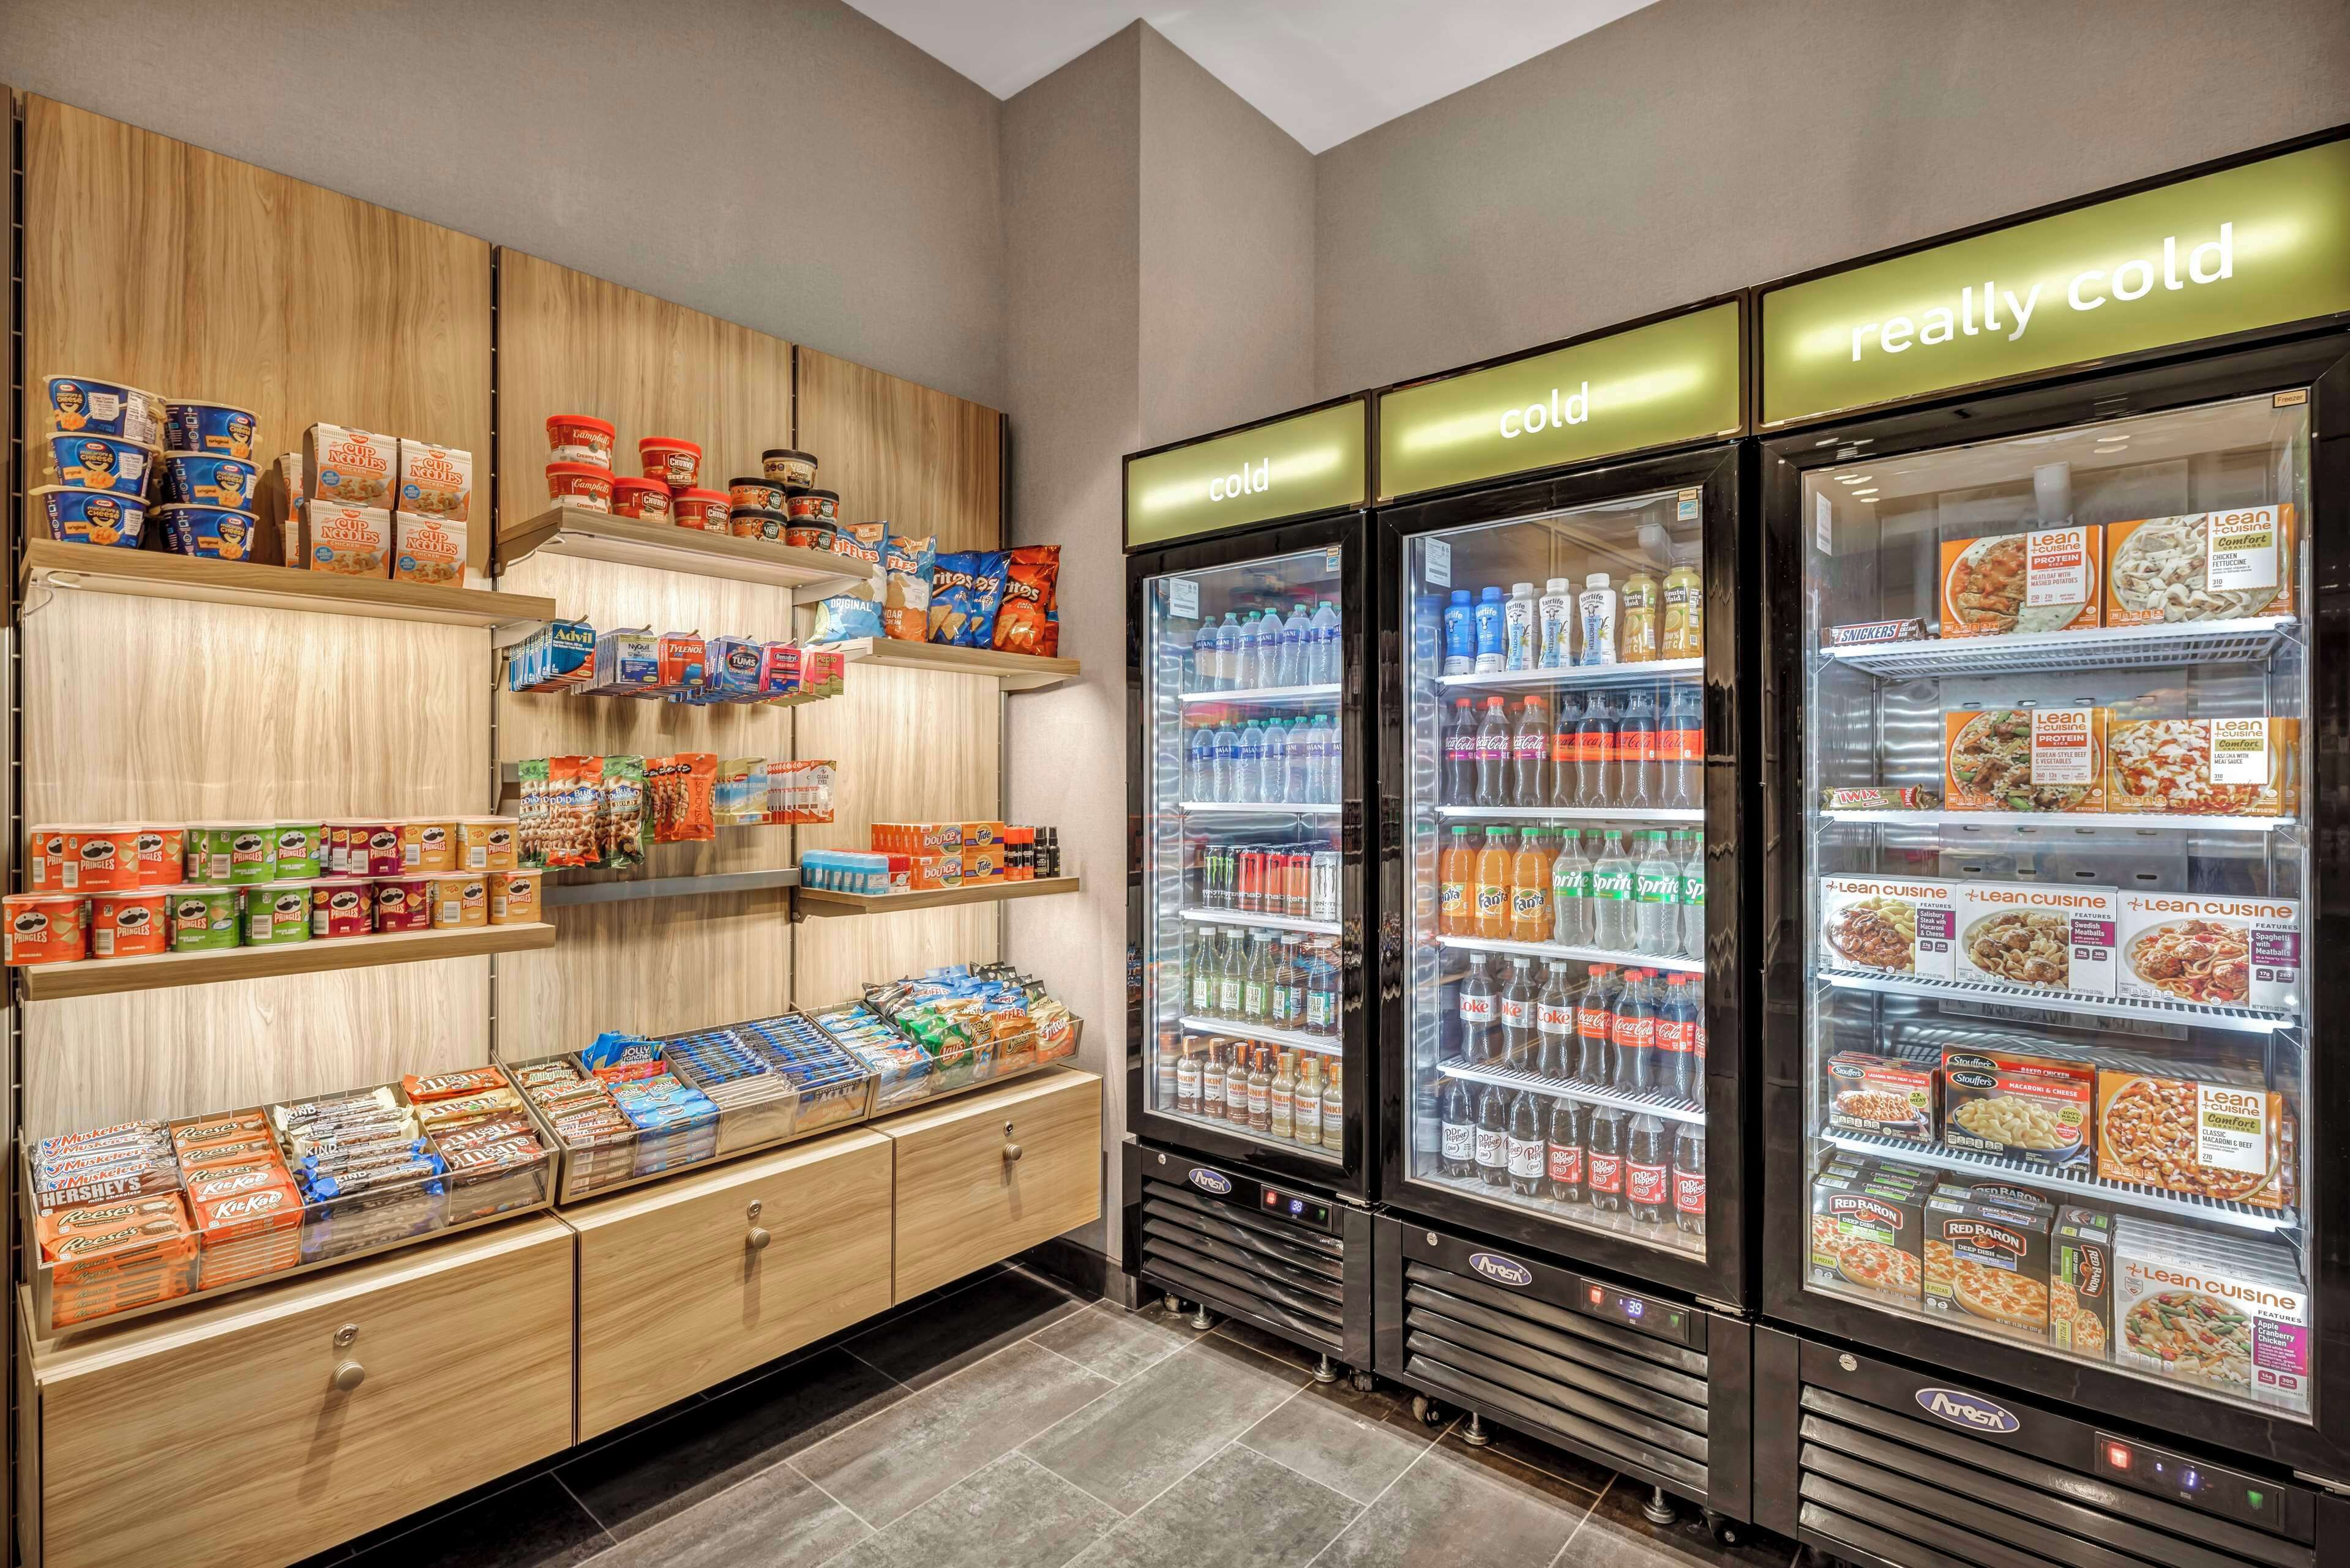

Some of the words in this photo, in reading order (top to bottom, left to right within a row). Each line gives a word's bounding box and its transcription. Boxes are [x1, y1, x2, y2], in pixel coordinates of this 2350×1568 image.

[1850, 276, 2041, 362] really
[2067, 222, 2233, 312] cold
[2277, 394, 2303, 403] Freezer
[1498, 383, 1589, 440] cold
[343, 443, 375, 455] CUP
[329, 451, 386, 470] NOODLES
[423, 458, 452, 470] CUP
[669, 458, 693, 470] CHUNKY
[411, 465, 462, 483] NOODLES
[1208, 458, 1270, 501] cold
[644, 496, 667, 508] CHUNKY
[335, 518, 368, 531] CUP
[321, 526, 379, 543] NOODLES
[2032, 531, 2081, 546] Lean
[2218, 534, 2267, 547] Comfort
[2034, 554, 2078, 564] PROTEIN
[2213, 559, 2247, 567] FETTUCCINE
[934, 571, 972, 589] ritos
[1581, 594, 1603, 603] fairlife
[831, 599, 872, 611] ORIGINAL
[555, 629, 592, 643] Advil
[1841, 625, 1897, 642] SNICKERS
[670, 644, 703, 653] TYLENOL
[733, 657, 755, 666] TUMS
[817, 655, 836, 663] Pepto
[2038, 713, 2086, 723] Lean
[608, 790, 639, 800] DIAMOND
[695, 782, 703, 823] PISTACHIOS
[924, 831, 956, 848] bounce
[976, 829, 991, 842] Tide
[234, 852, 262, 862] PRINGLES
[370, 848, 396, 858] PRINGLES
[81, 858, 114, 870] PRINGLES
[1593, 873, 1633, 891] Sprite
[1636, 875, 1678, 894] Sprite
[1839, 883, 1880, 894] Lean
[463, 898, 484, 908] PRINGLES
[1478, 886, 1508, 910] Fanta
[1980, 891, 2027, 903] Lean
[2146, 899, 2199, 913] Lean
[331, 909, 358, 919] PRINGLES
[178, 919, 206, 929] PRINGLES
[14, 931, 47, 943] PRINGLES
[2256, 933, 2290, 942] Spaghetti
[2256, 947, 2291, 956] Meatballs
[1538, 1006, 1570, 1024] Coke
[1042, 1018, 1066, 1040] Fritos
[623, 1045, 651, 1057] JOLLY
[623, 1053, 651, 1061] rancher
[1836, 1067, 1862, 1077] Stouffer's
[1956, 1074, 1992, 1086] Stouffer's
[2010, 1083, 2043, 1092] MACARONI
[2204, 1091, 2258, 1108] Lean
[288, 1107, 316, 1120] KIND
[2208, 1113, 2255, 1128] Comfort
[42, 1137, 59, 1151] 3
[61, 1121, 144, 1146] Musketeers
[2202, 1129, 2226, 1138] CLASSIC
[2202, 1136, 2232, 1146] MACARONI
[305, 1143, 337, 1156] KIND
[1633, 1171, 1656, 1187] Pepper
[43, 1176, 141, 1208] HERSHEY'S
[107, 1190, 141, 1201] chocolate
[1292, 1201, 1302, 1212] 38
[1835, 1198, 1856, 1208] RED
[1858, 1200, 1896, 1222] BARON
[59, 1205, 136, 1226] Reese's
[1950, 1223, 1973, 1234] RED
[1975, 1225, 2019, 1247] BARON
[2144, 1267, 2200, 1290] Lean
[1628, 1301, 1642, 1315] 39
[2258, 1310, 2302, 1323] FEATURES
[2258, 1320, 2278, 1330] Apple
[2258, 1327, 2294, 1342] Cranberry
[2258, 1335, 2286, 1346] Chicken
